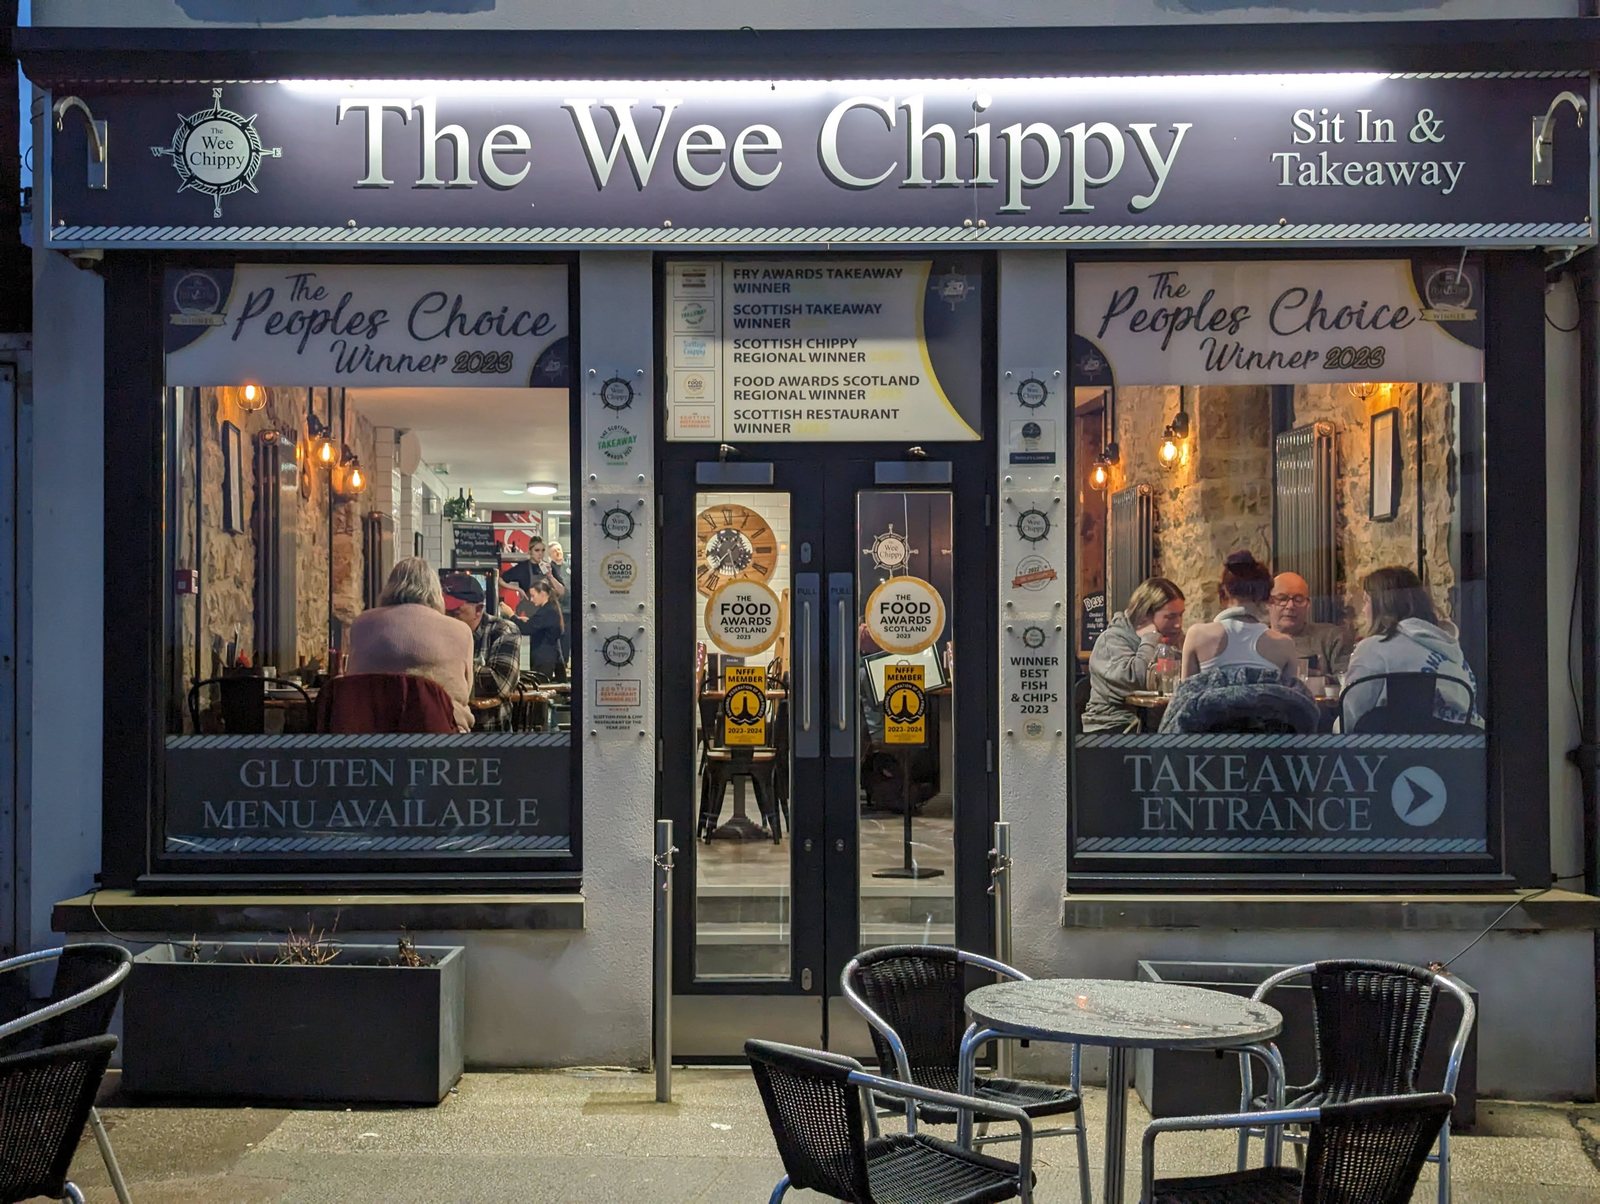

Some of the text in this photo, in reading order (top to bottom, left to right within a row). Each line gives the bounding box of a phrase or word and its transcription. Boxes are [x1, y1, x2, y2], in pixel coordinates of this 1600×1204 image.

[1291, 108, 1446, 144] Sit In &
[202, 136, 234, 150] Wee
[338, 94, 1193, 213] The Wee Chippy
[190, 152, 245, 169] Chippy
[1270, 150, 1466, 194] Takeaway
[734, 268, 903, 279] FRY AWARDS TAKEAWAY
[285, 272, 328, 302] The
[734, 283, 790, 293] WINNER
[1148, 270, 1191, 299] The
[734, 304, 882, 315] SCOTTISH TAKEAWAY
[232, 288, 556, 354] Peoples Choice
[734, 318, 791, 329] WINNER
[1096, 286, 1415, 351] Peoples Choice
[734, 338, 858, 349] SCOTTISH CHIPPY
[330, 339, 448, 374] Winner
[451, 350, 514, 374] 2023
[734, 352, 806, 362] REGIONAL
[808, 352, 866, 362] WINNER
[1200, 337, 1387, 372] Winner 2023
[734, 376, 920, 386] FOOD AWARDS SCOTLAND
[734, 390, 806, 400] REGIONAL
[808, 390, 866, 400] WINNER
[734, 409, 899, 420] SCOTTISH RESTAURANT
[734, 423, 791, 434] WINNER
[598, 435, 637, 450] TAKEAWAY
[721, 603, 771, 616] FOOD
[880, 602, 930, 614] FOOD
[720, 617, 771, 626] AWARDS
[880, 616, 931, 624] AWARDS
[1010, 657, 1059, 666] WINNER
[1020, 669, 1049, 678] BEST
[1021, 681, 1048, 690] FISH
[1011, 694, 1058, 702] & CHIPS
[1020, 705, 1048, 714] 2023
[240, 758, 503, 788] GLUTEN FREE
[1123, 755, 1388, 793] TAKEAWAY
[202, 799, 540, 829] MENU AVAILABLE
[1141, 797, 1372, 831] ENTRANCE
